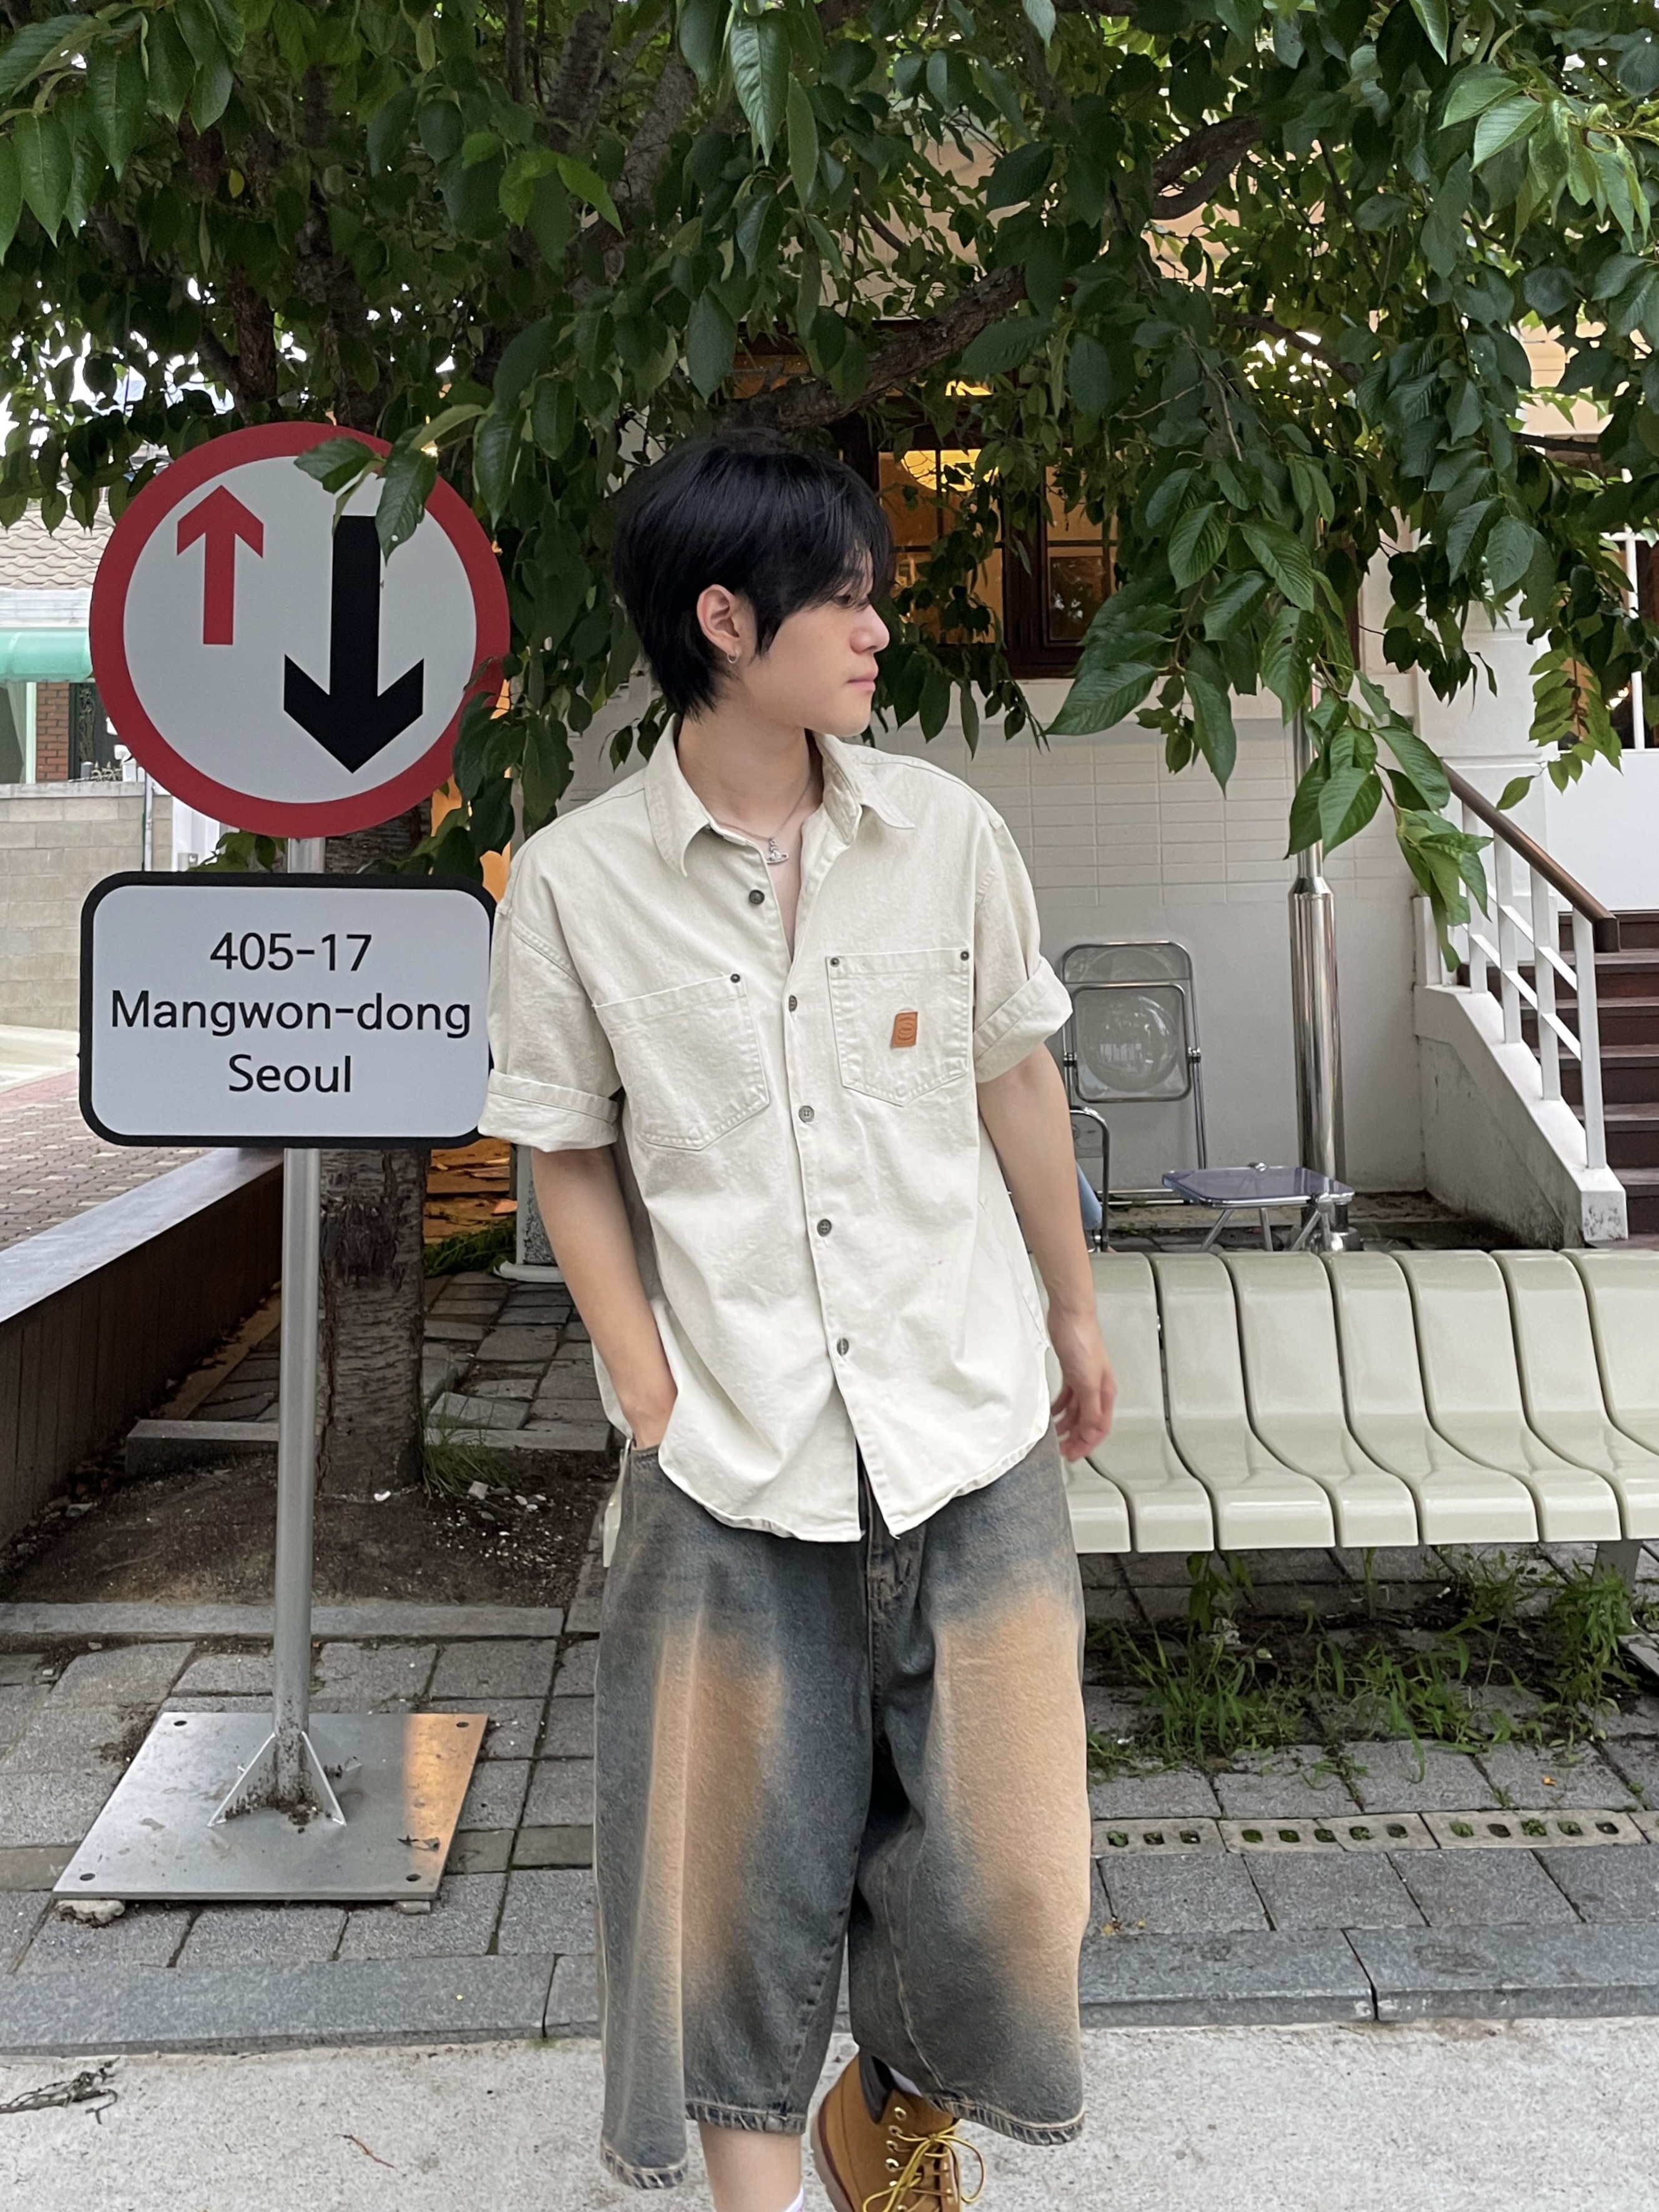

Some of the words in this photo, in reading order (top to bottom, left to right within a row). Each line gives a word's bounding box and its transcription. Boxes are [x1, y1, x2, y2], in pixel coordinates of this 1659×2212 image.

[210, 932, 373, 972] 405-17
[111, 990, 471, 1039] Mangwon-dong
[228, 1054, 351, 1093] Seoul
